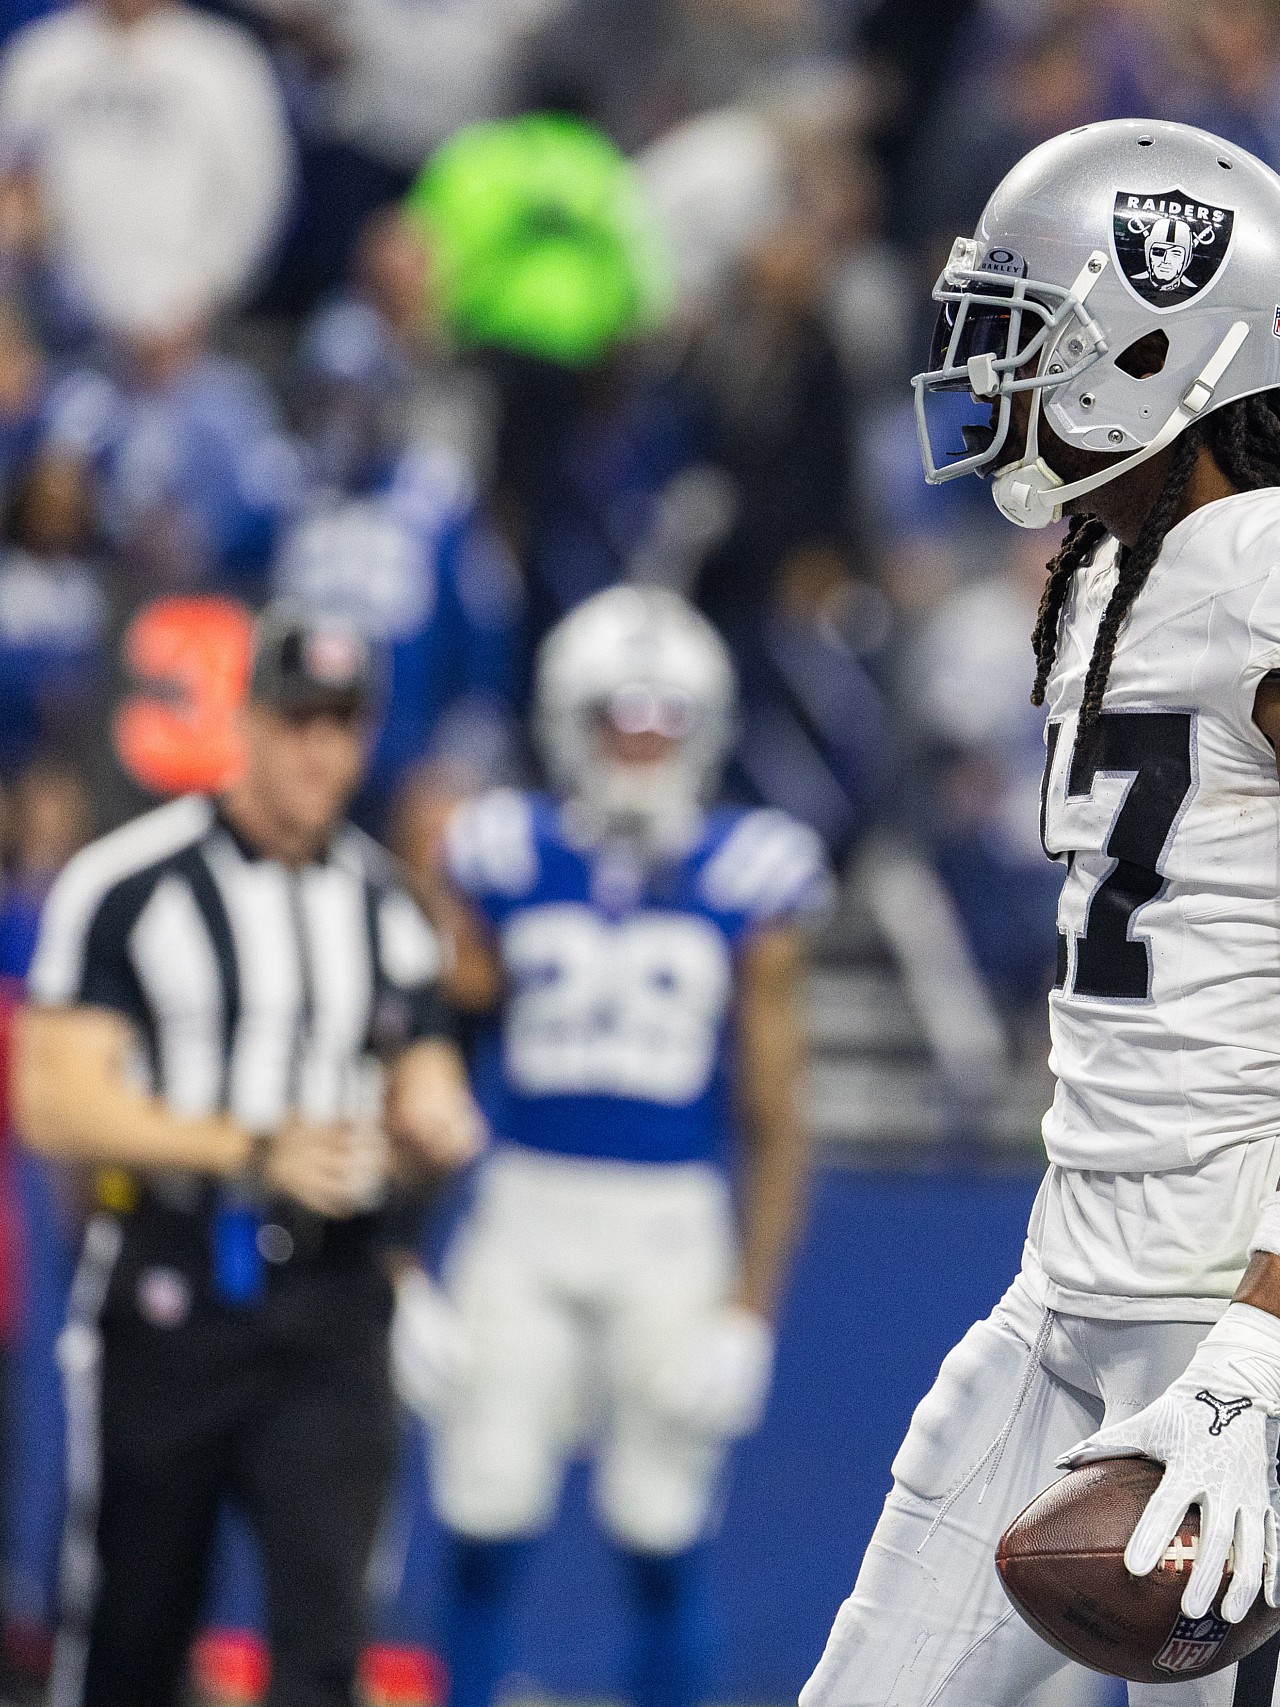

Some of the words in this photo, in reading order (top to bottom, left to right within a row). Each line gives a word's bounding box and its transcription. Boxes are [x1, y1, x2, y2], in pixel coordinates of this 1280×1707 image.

[1127, 196, 1225, 223] RAIDERS
[981, 262, 1020, 273] OAKLEY
[1162, 1640, 1214, 1670] NFL
